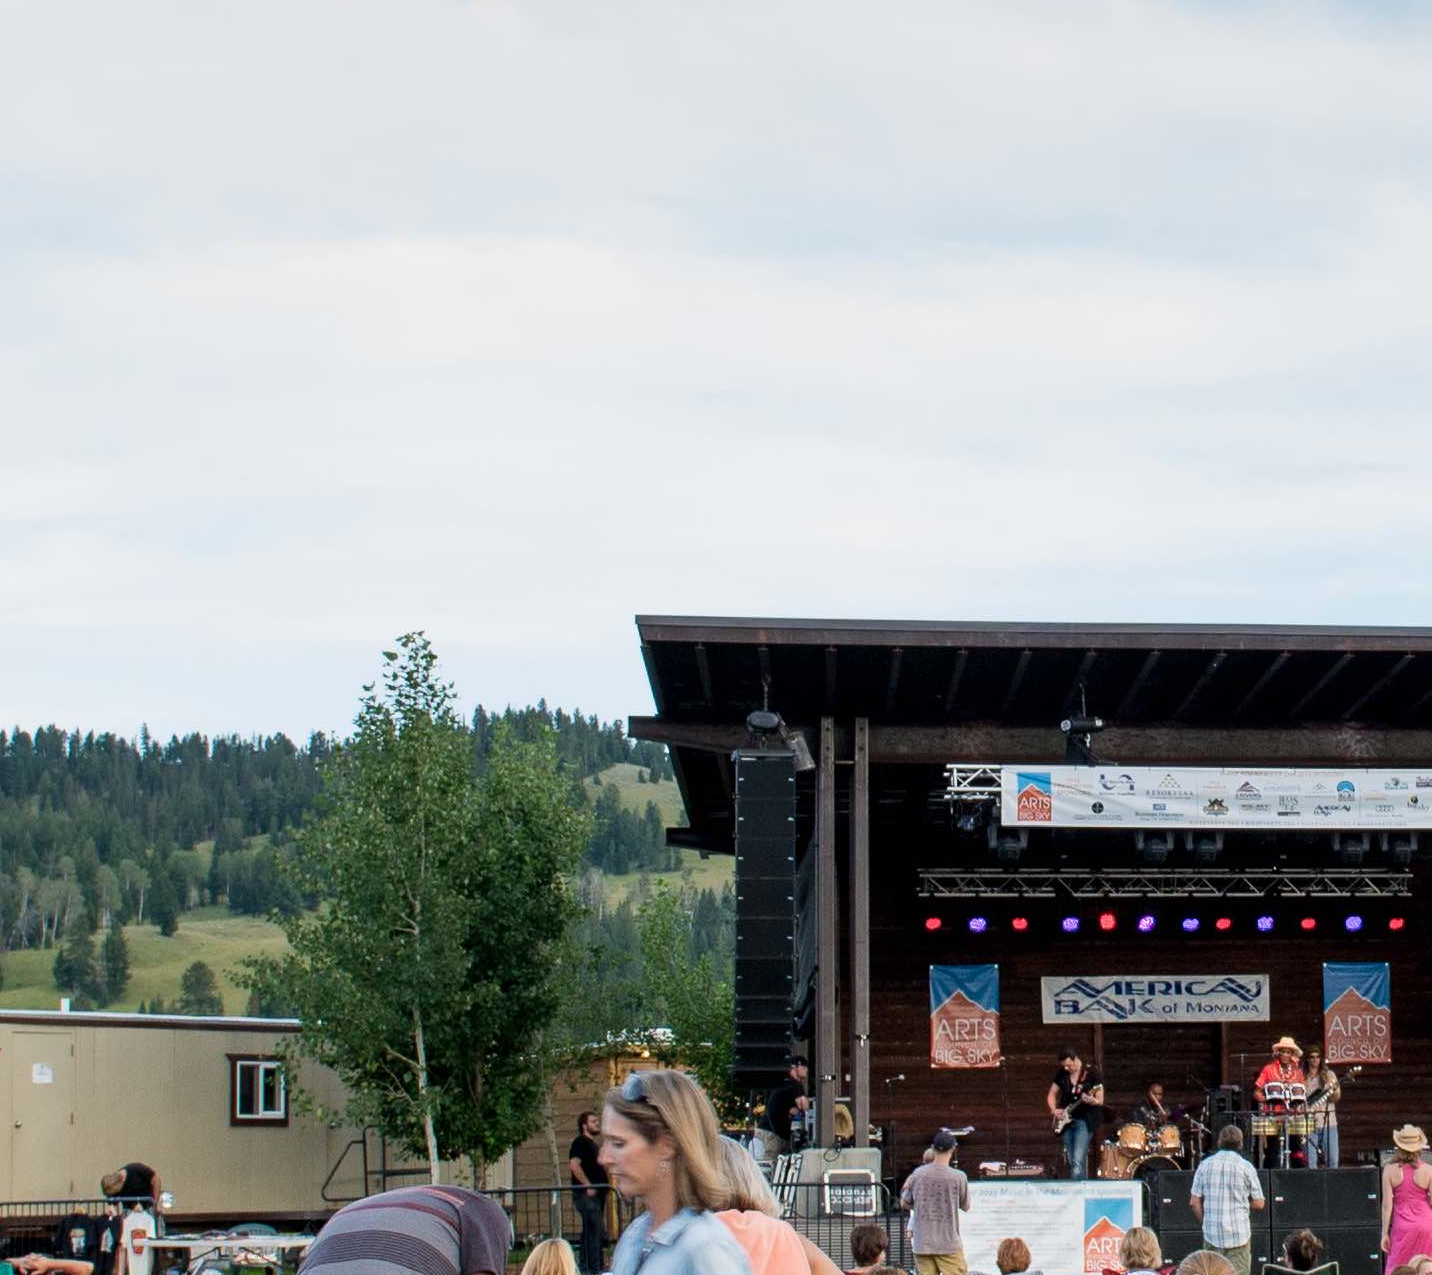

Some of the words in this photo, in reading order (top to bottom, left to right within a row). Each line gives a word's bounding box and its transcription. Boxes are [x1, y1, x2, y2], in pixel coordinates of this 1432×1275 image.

[1019, 796, 1051, 810] ARTS
[1162, 1001, 1179, 1014] of
[935, 1017, 997, 1041] ARTS
[1328, 1014, 1388, 1038] ARTS
[935, 1049, 963, 1064] BIG
[967, 1048, 997, 1064] SKY
[1328, 1045, 1356, 1060] BIG
[1359, 1044, 1388, 1060] SKY
[1086, 1260, 1105, 1271] BIG
[1110, 1260, 1126, 1271] SK
